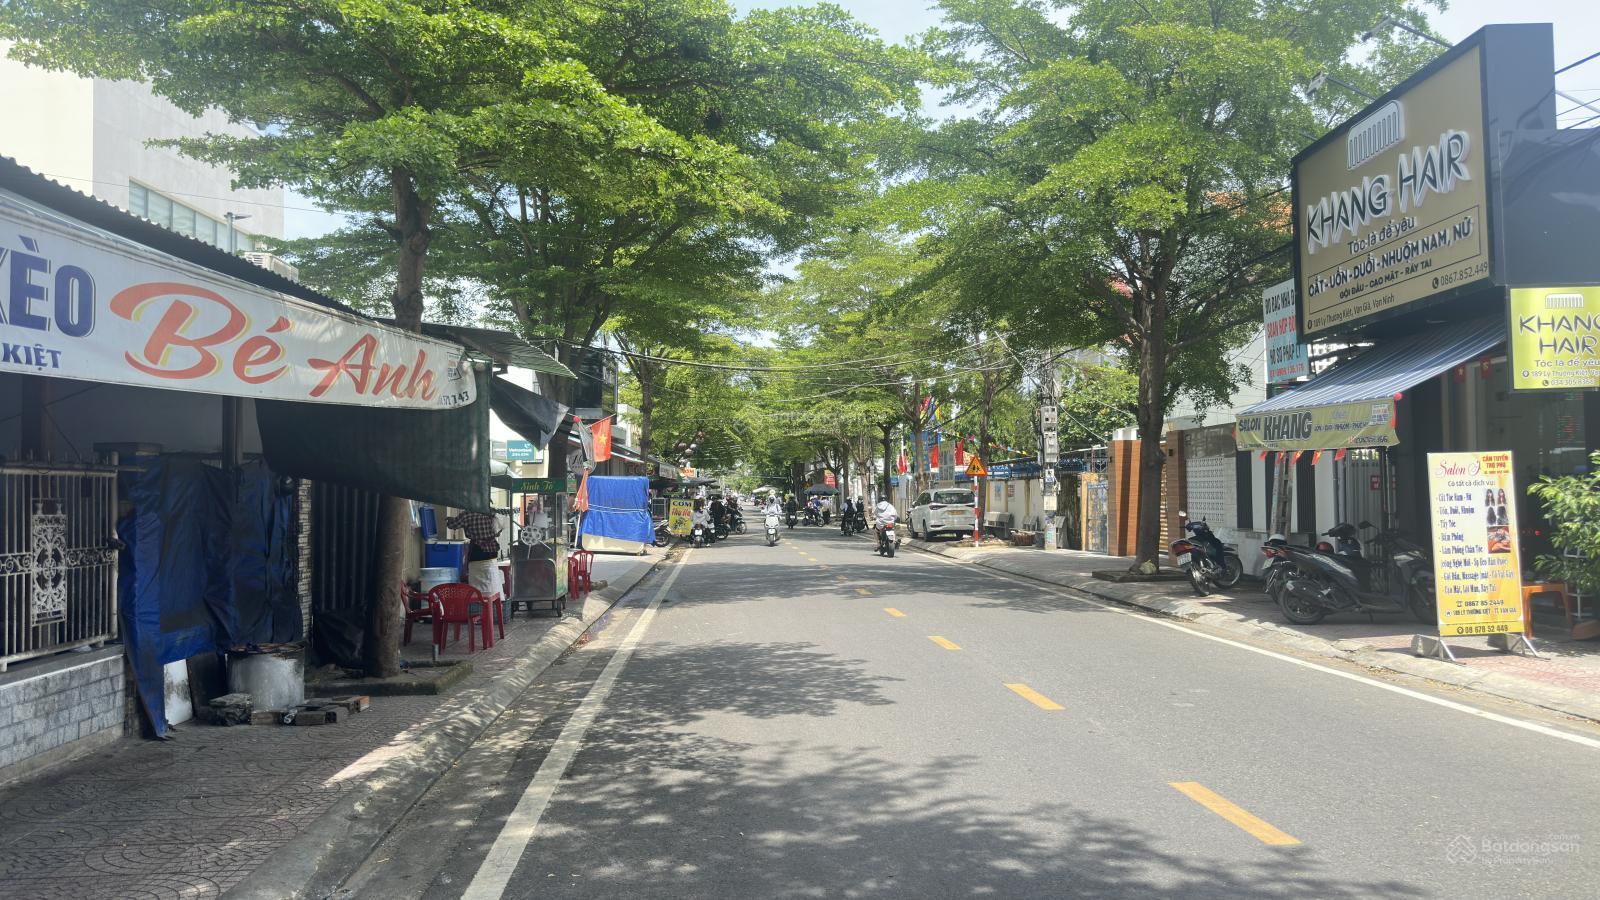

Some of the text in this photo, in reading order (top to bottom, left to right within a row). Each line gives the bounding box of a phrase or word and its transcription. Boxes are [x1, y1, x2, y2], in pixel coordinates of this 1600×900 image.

[1307, 129, 1472, 254] KHANG HAIR
[1347, 238, 1366, 254] Tóc
[1367, 231, 1377, 247] là
[1395, 216, 1416, 239] yêu
[1308, 275, 1326, 297] CẮT
[1329, 266, 1350, 288] UỐN
[1381, 240, 1420, 267] NHUỘM
[1421, 229, 1451, 252] NAM,
[1453, 215, 1473, 241] NỮ
[1420, 258, 1432, 270] TAI
[1440, 261, 1488, 287] 0867.852.449
[109, 281, 292, 384] Bé
[307, 333, 438, 401] Anh
[1539, 335, 1598, 356] HAIR
[1, 343, 62, 371] KIỆT
[1535, 358, 1552, 368] Tóc
[1238, 417, 1261, 432] SALON
[1263, 410, 1313, 442] KHANG
[1438, 460, 1467, 477] Salon
[521, 480, 541, 491] Sinh
[1488, 625, 1495, 633] 52
